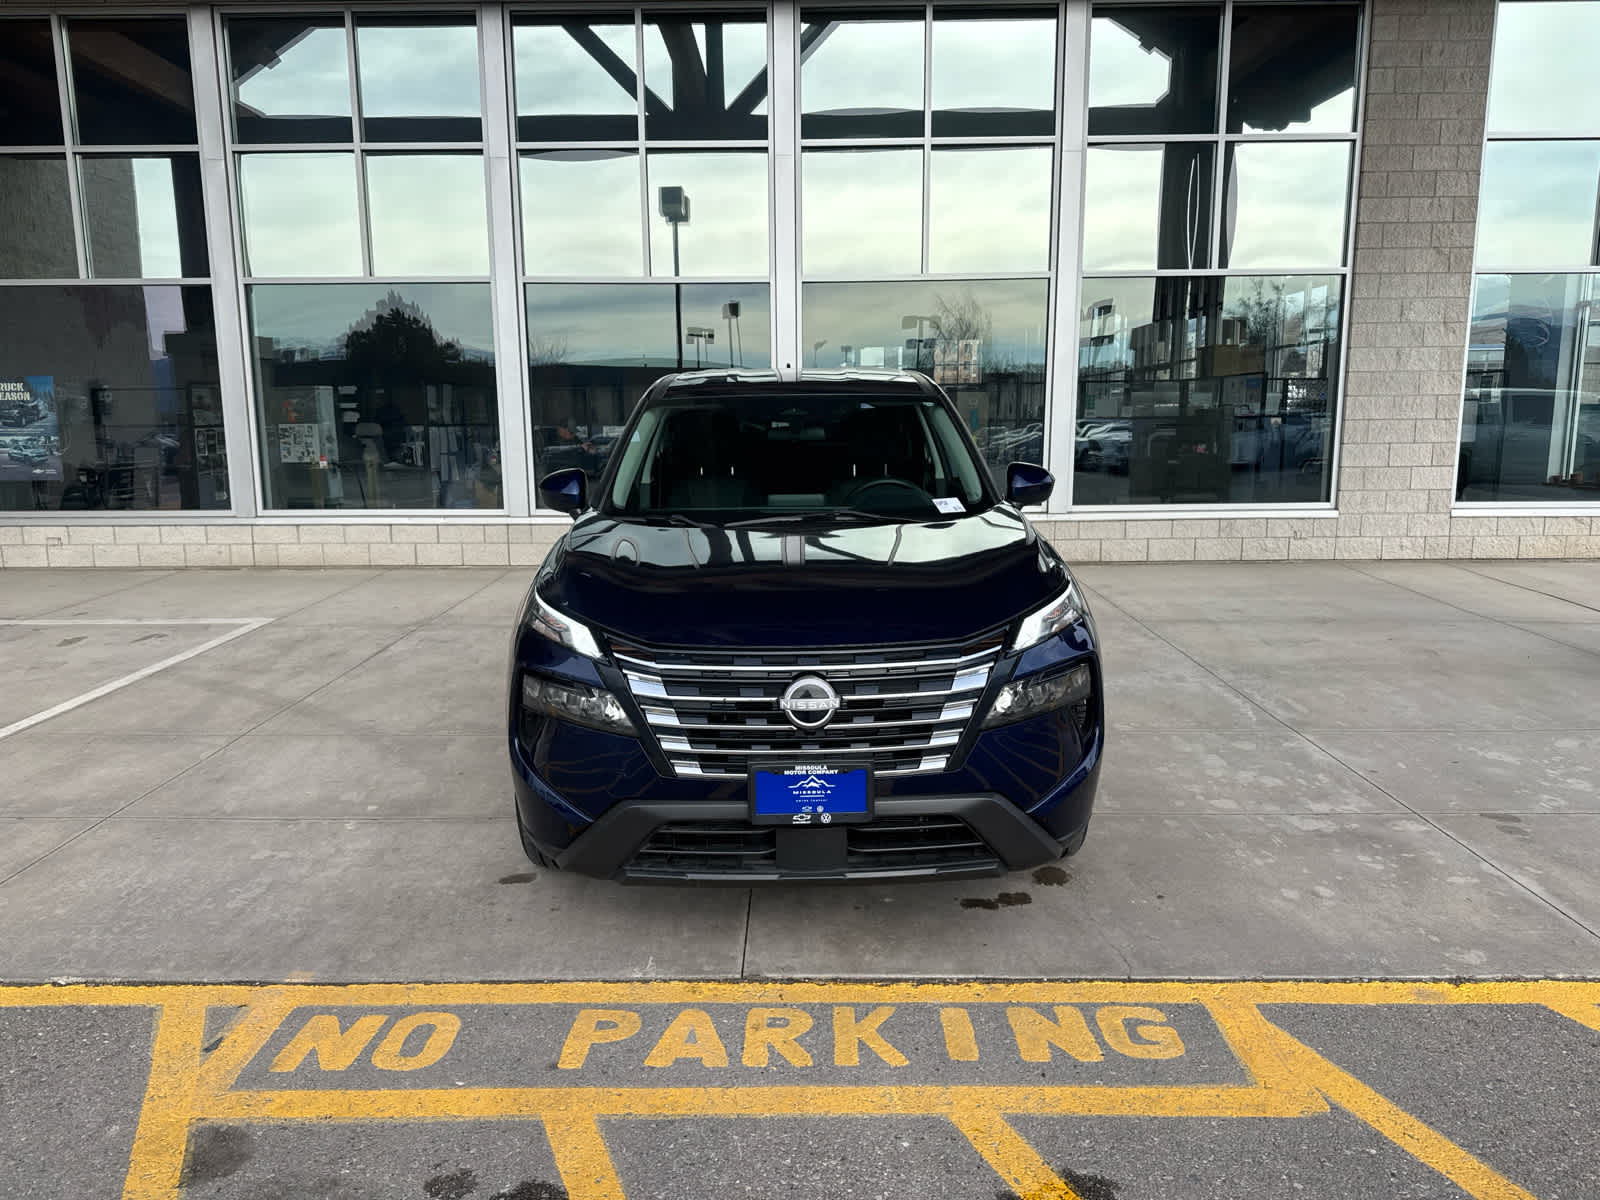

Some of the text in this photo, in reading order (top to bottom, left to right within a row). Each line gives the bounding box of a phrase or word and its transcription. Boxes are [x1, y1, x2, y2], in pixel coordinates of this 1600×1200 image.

[781, 700, 840, 709] NISSAN
[268, 1005, 1186, 1074] NO PARKING
